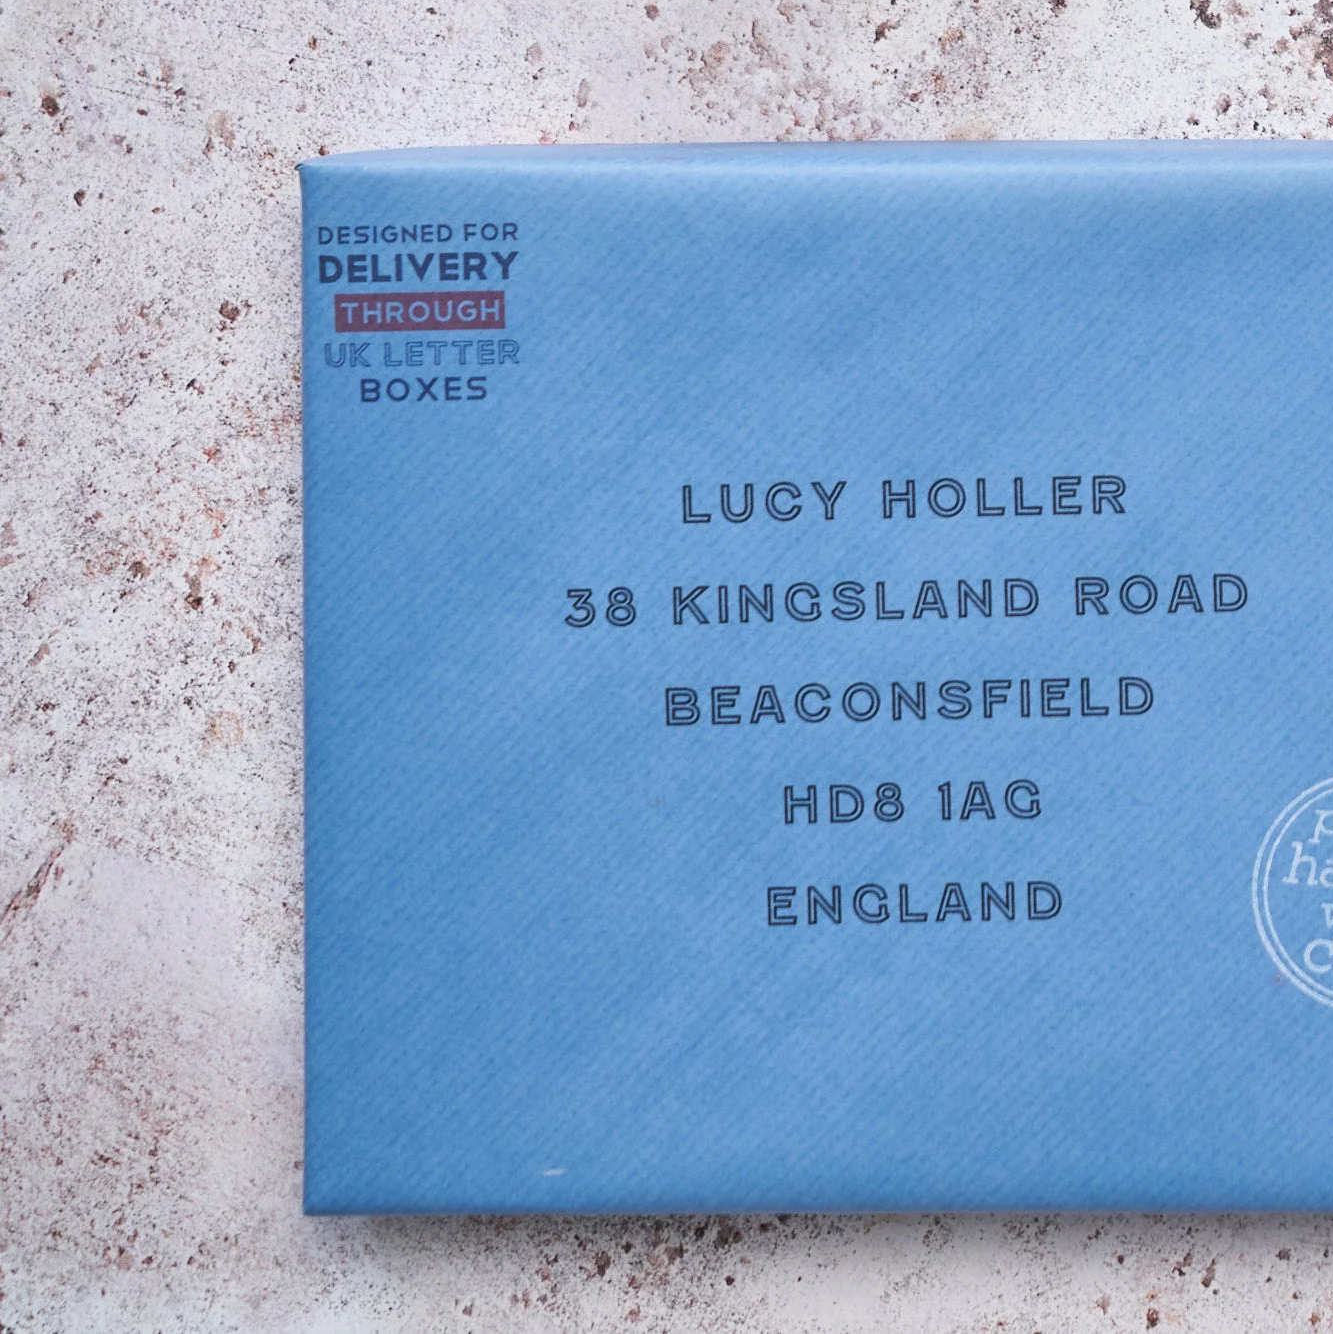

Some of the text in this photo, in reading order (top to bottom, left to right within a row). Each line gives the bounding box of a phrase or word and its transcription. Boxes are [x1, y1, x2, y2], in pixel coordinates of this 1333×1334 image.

[318, 222, 519, 245] DESIGNED FOR
[319, 251, 519, 284] DELIVERY
[340, 299, 500, 325] THROUGH
[324, 339, 520, 367] UK LETTER
[360, 376, 488, 403] BOXES
[682, 474, 1127, 524] LUCY HOLLER
[564, 573, 1249, 629] 38 KINGSLAND ROAD
[665, 676, 1155, 727] BEACONSFIELD
[783, 778, 1042, 825] HD8 1AG
[767, 880, 1063, 927] ENGLAND
